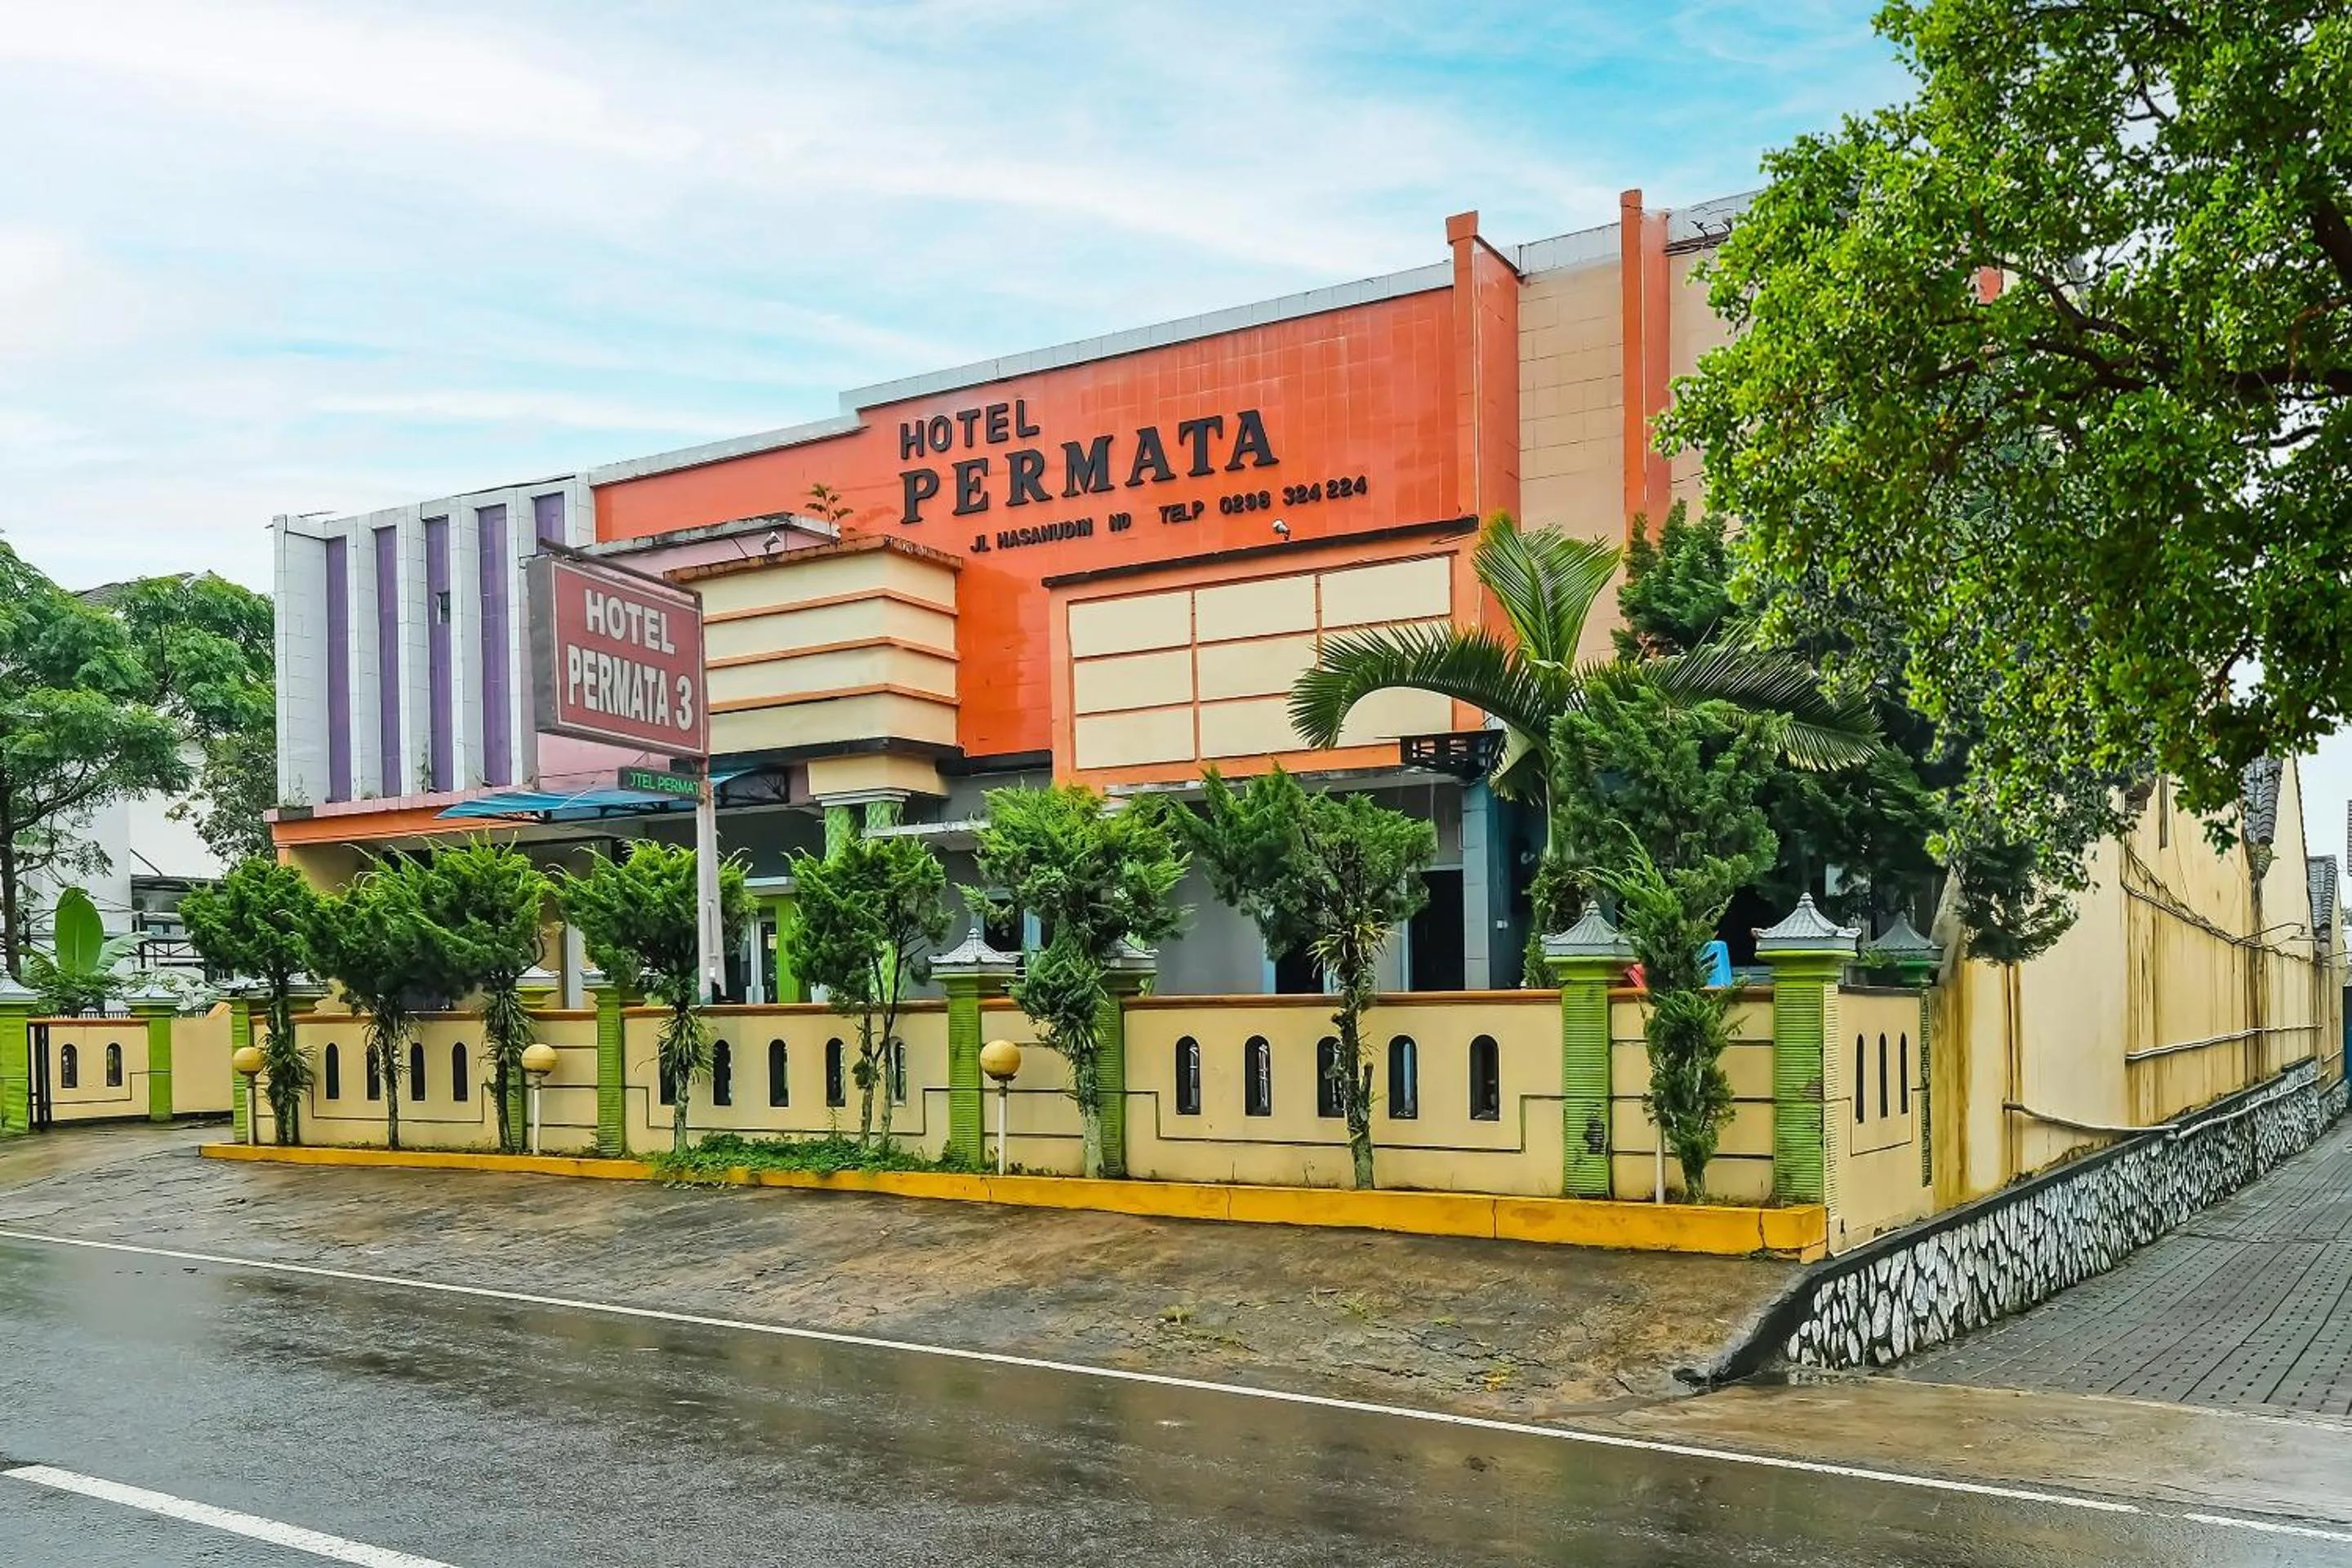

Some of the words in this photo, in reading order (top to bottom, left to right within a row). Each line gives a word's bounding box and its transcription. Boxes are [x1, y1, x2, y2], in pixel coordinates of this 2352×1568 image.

[899, 409, 1280, 525] PERMATA
[900, 399, 1040, 460] HOTEL
[996, 518, 1094, 550] HASANUDIN
[1108, 512, 1131, 532] NO
[1159, 501, 1205, 524] TELP
[1282, 483, 1321, 506] 324
[1326, 475, 1368, 500] 224
[585, 589, 676, 655] HOTEL
[567, 644, 670, 727] PERMATA
[675, 675, 693, 731] 3
